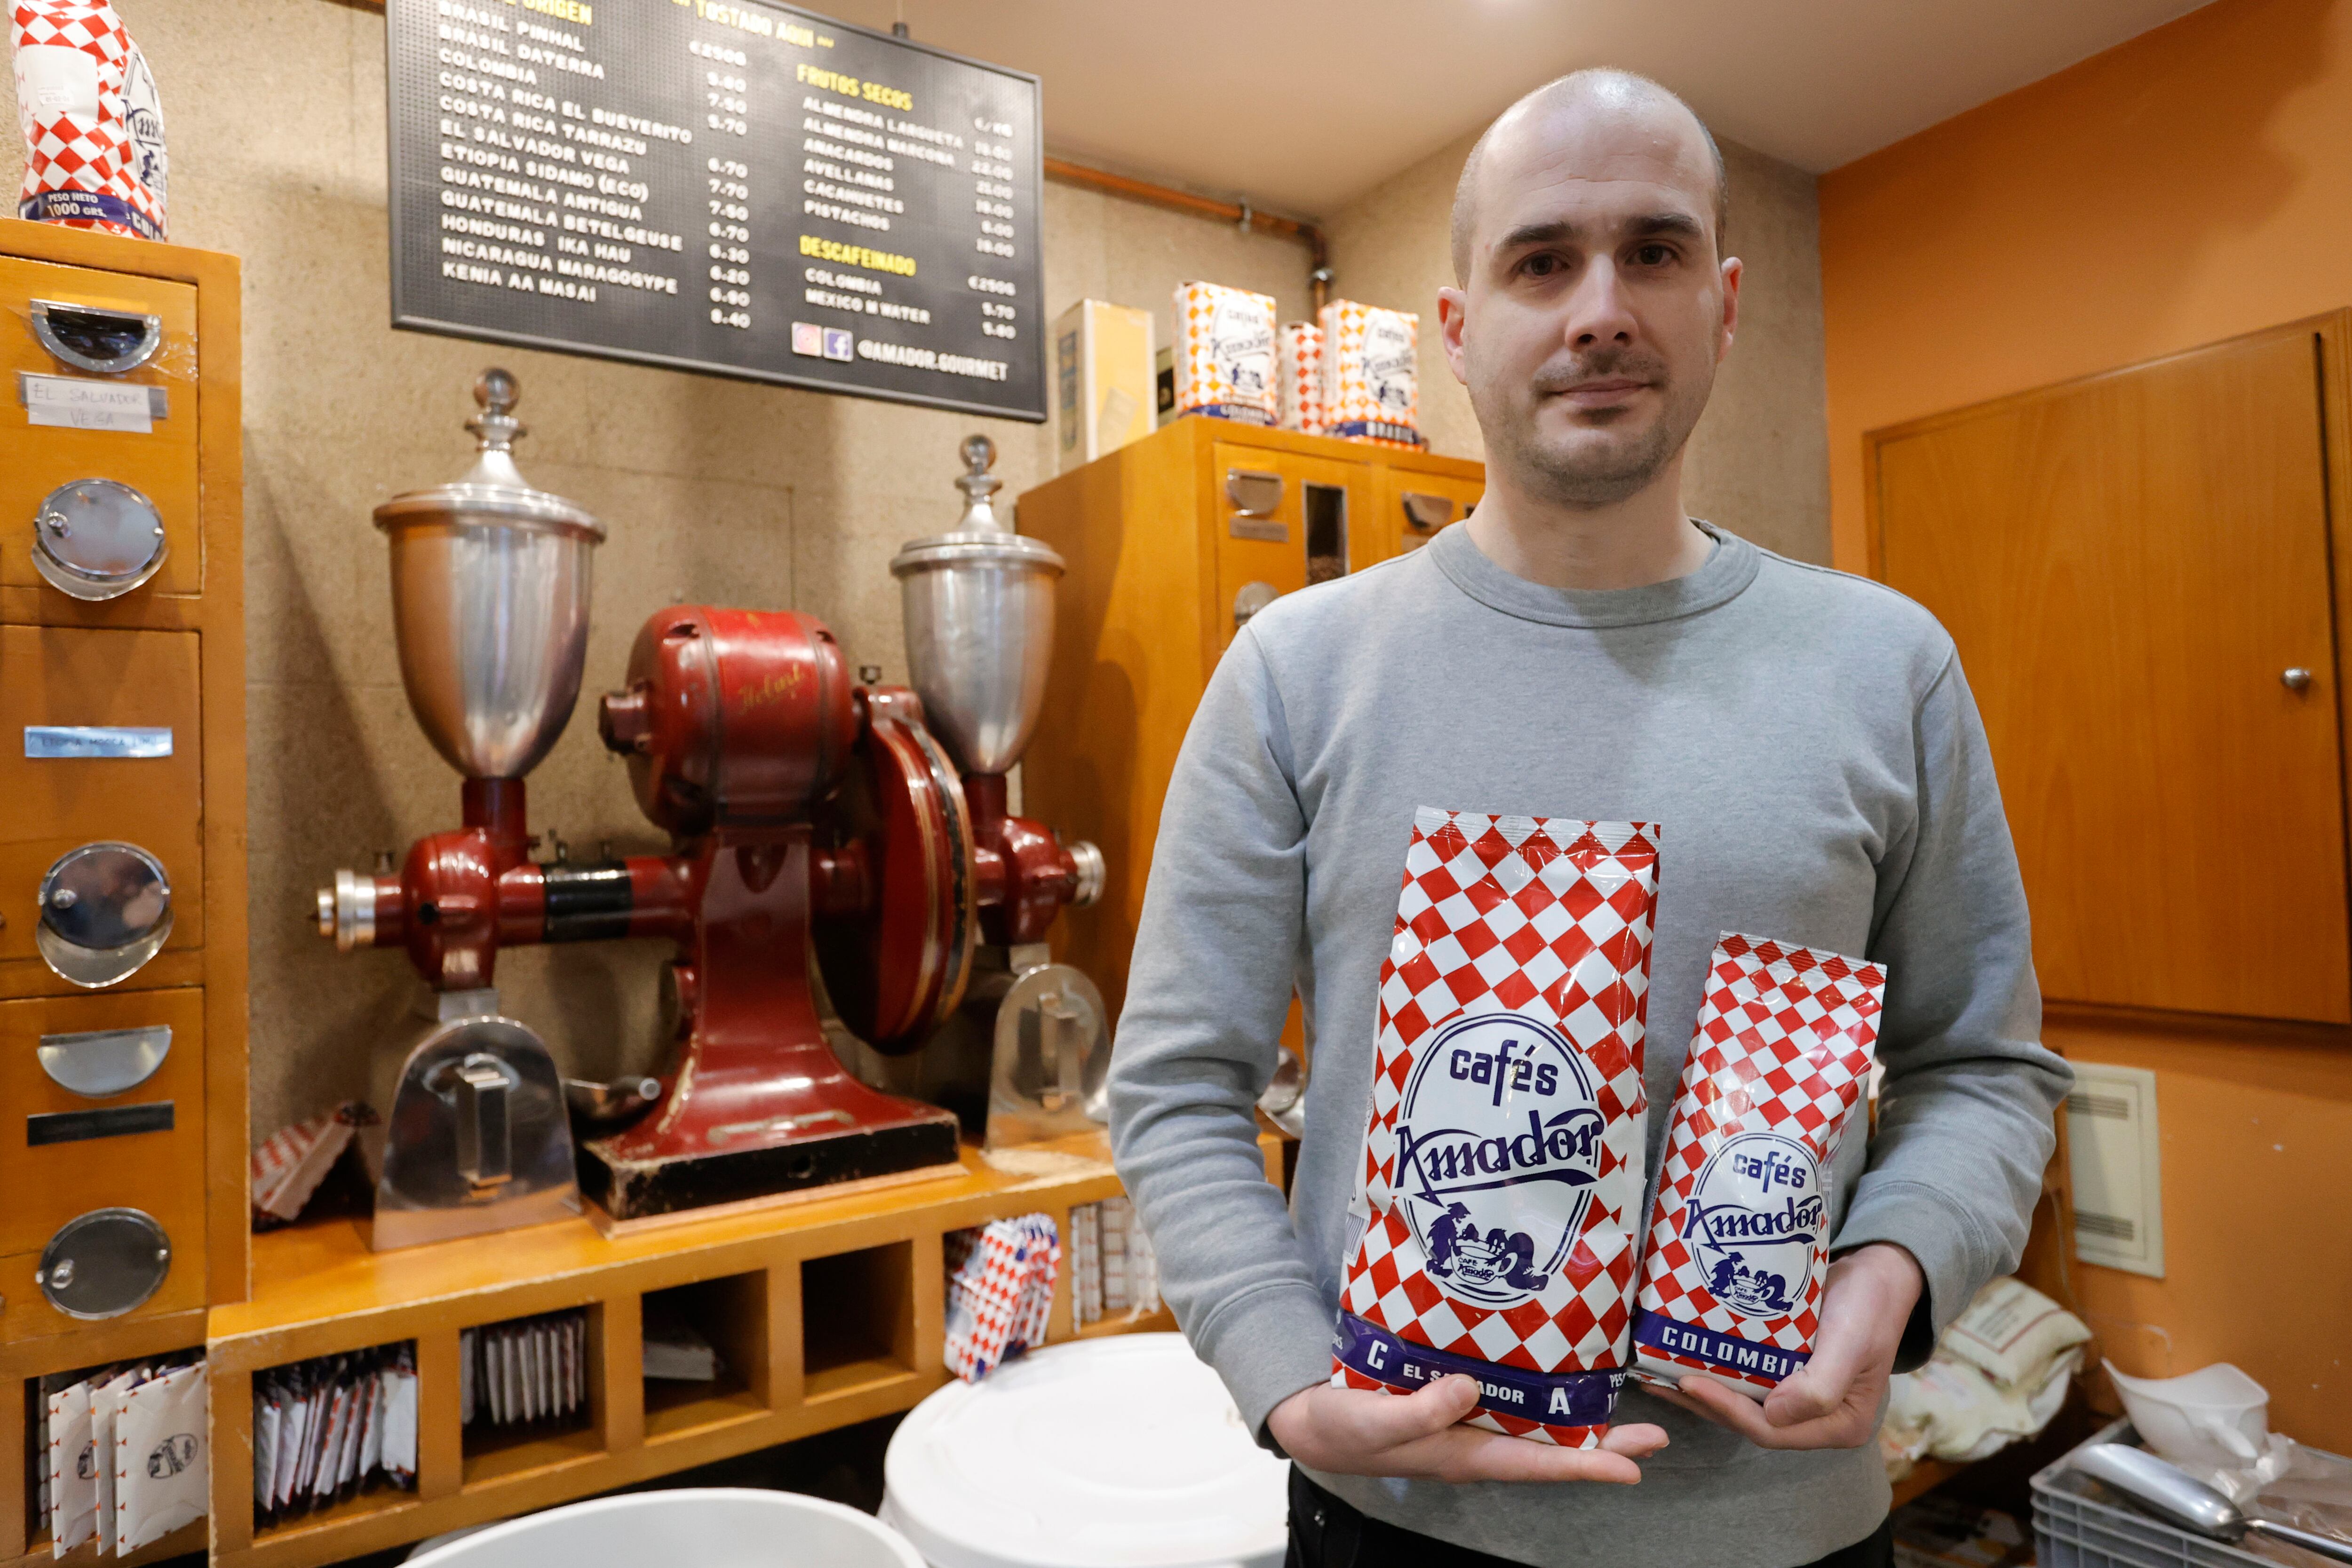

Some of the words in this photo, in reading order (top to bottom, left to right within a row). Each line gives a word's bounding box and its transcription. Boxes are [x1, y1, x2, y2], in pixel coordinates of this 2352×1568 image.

[439, 0, 510, 32] BRASIL
[517, 20, 586, 53] PINHAL
[696, 0, 773, 36] TOSTADO
[438, 24, 510, 56] BRASIL
[517, 43, 605, 80] DATERRA
[438, 48, 538, 86] COLOMBIA
[439, 71, 506, 101] COSTA
[511, 88, 556, 113] RICA
[562, 100, 586, 120] EL
[591, 107, 693, 144] BUEYERITO
[796, 63, 860, 97] FRUTOS
[862, 81, 914, 111] SECOS
[439, 95, 506, 124] COSTA
[512, 111, 557, 135] RICA
[561, 123, 647, 156] TARRAZU
[802, 96, 885, 130] ALMENDRA
[440, 119, 466, 138] EL
[473, 126, 576, 163] SALVADOR
[580, 150, 630, 175] VEGA
[803, 117, 885, 150] ALMENDRA
[886, 137, 956, 167] MARCONA
[803, 137, 894, 172] ANACARDOS
[440, 142, 520, 174] ETIOPIA
[524, 160, 595, 189] SIDAMO
[597, 173, 649, 203] (ECO)
[440, 166, 558, 205] GUATEMALA
[563, 191, 643, 222] ANTIGUA
[708, 178, 749, 200] 7.70
[803, 158, 895, 192] AVELLANAS
[803, 178, 905, 215] CACAHUETES
[48, 192, 70, 203] PESO
[72, 193, 99, 204] NETO
[48, 202, 80, 217] 1000
[82, 206, 108, 218] GRS.
[441, 189, 559, 227] GUATEMALA
[563, 214, 683, 252] BETELGEUSE
[804, 199, 891, 232] PISTACHOS
[441, 213, 546, 247] HONDURAS
[557, 235, 589, 256] IKA
[594, 242, 632, 263] HAU
[799, 234, 917, 278] DESCAFEINADO
[441, 236, 554, 272] NICARAGUA
[557, 258, 679, 295] MARAGOGYPE
[442, 260, 503, 287] KENIA
[508, 272, 535, 292] AA
[539, 278, 597, 303] MASAI
[804, 267, 882, 296] COLOMBIA
[804, 287, 864, 312] MEXICO
[879, 302, 931, 326] WATER
[857, 339, 1009, 382] @AMADOR.GOURMET
[1449, 1039, 1559, 1107] cafés
[1394, 1106, 1605, 1208] Amador
[1732, 1150, 1806, 1194] cafés
[1682, 1196, 1823, 1253] Amador
[1661, 1324, 1804, 1376] COLOMBIA
[1367, 1339, 1389, 1370] C
[1403, 1363, 1424, 1380] EL
[1429, 1369, 1525, 1405] SADOR
[1548, 1387, 1571, 1415] A
